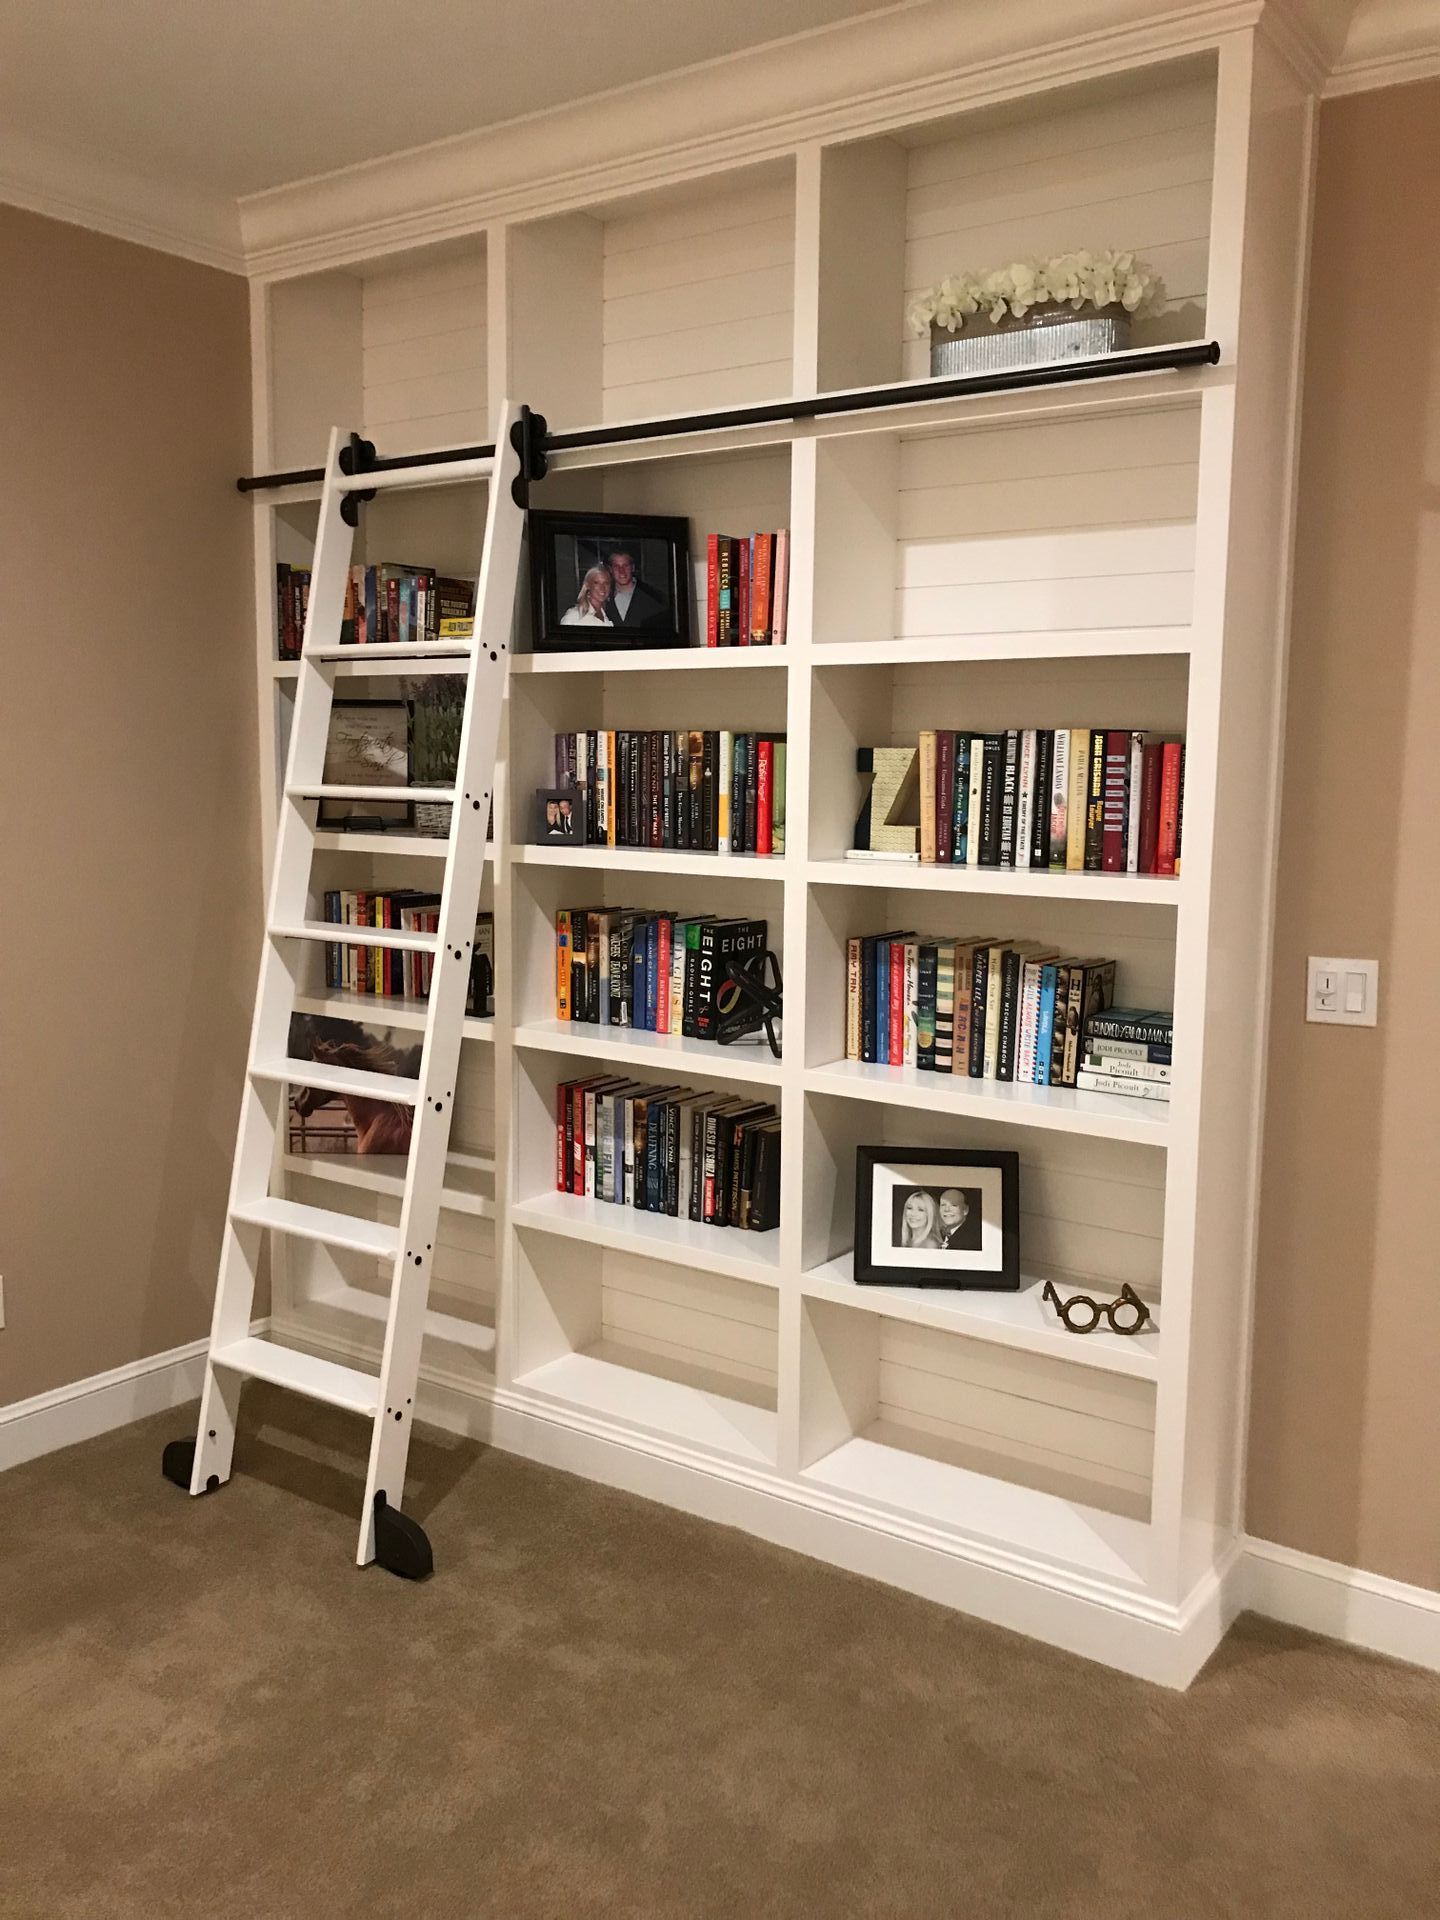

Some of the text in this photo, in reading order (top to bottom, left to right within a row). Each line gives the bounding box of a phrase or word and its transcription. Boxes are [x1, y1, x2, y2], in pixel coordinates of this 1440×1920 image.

[721, 552, 729, 589] REBECCA
[747, 737, 755, 765] orphan
[1055, 733, 1066, 790] WILLIAM LANDAY
[958, 762, 965, 772] Ng
[1004, 765, 1015, 793] BLACK
[1022, 761, 1030, 789] FLYNN
[1092, 735, 1103, 797] JOHN GRISHAM
[1088, 804, 1096, 830] Lawyer
[1096, 800, 1104, 822] Rogue
[610, 932, 621, 957] WATCHERS
[721, 934, 763, 953] EIGHT
[699, 936, 713, 1002] EIGHT
[974, 954, 983, 1000] HARPER LEE
[1025, 1002, 1033, 1029] ALWAYS
[1097, 1044, 1113, 1052] JODI
[1114, 1046, 1143, 1057] PICOULT
[1110, 1065, 1138, 1077] Picoult
[1094, 1078, 1139, 1092] Jodi Picoult
[648, 1122, 657, 1170] DEAFENING
[705, 1117, 716, 1177] DINESH D'SOUZA
[603, 1153, 612, 1174] FALL
